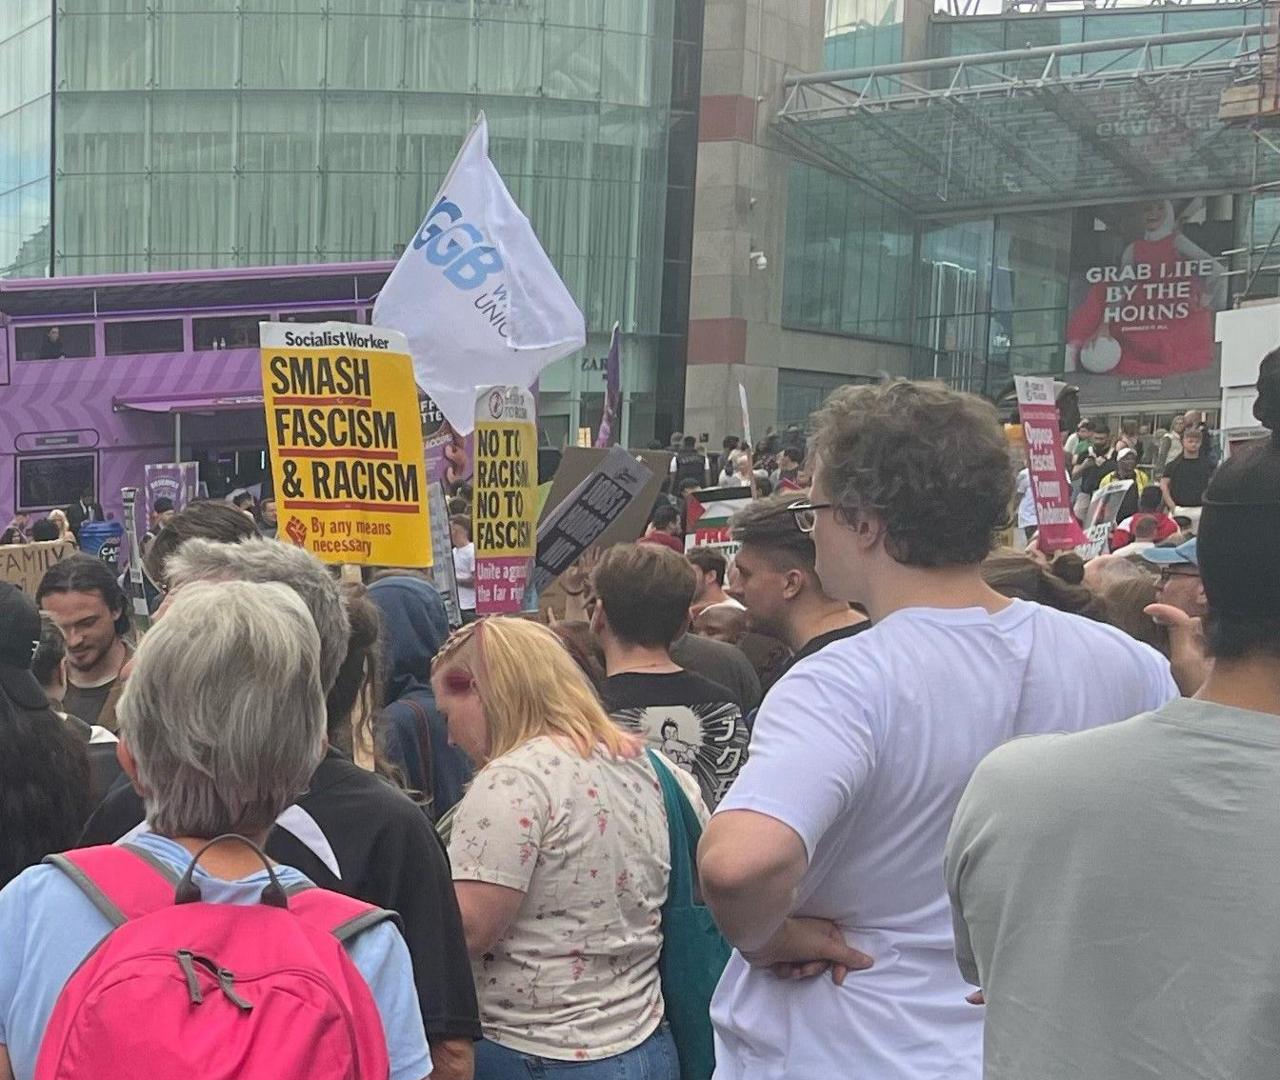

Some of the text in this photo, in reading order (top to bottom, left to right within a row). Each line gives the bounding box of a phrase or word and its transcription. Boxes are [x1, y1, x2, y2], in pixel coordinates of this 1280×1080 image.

[1086, 260, 1214, 284] GRAB LIFE
[1106, 282, 1191, 304] BY THE
[1104, 302, 1189, 323] HORNS
[285, 331, 390, 349] Socialist Worker
[270, 356, 371, 397] SMASH
[275, 408, 398, 449] FASCISM
[477, 430, 499, 457] NO
[282, 459, 419, 502] & RACISM
[477, 492, 500, 518] NO
[311, 517, 392, 537] By any means
[312, 539, 372, 556] necessary
[477, 562, 500, 579] Unite
[477, 586, 492, 602] the
[493, 585, 506, 601] far
